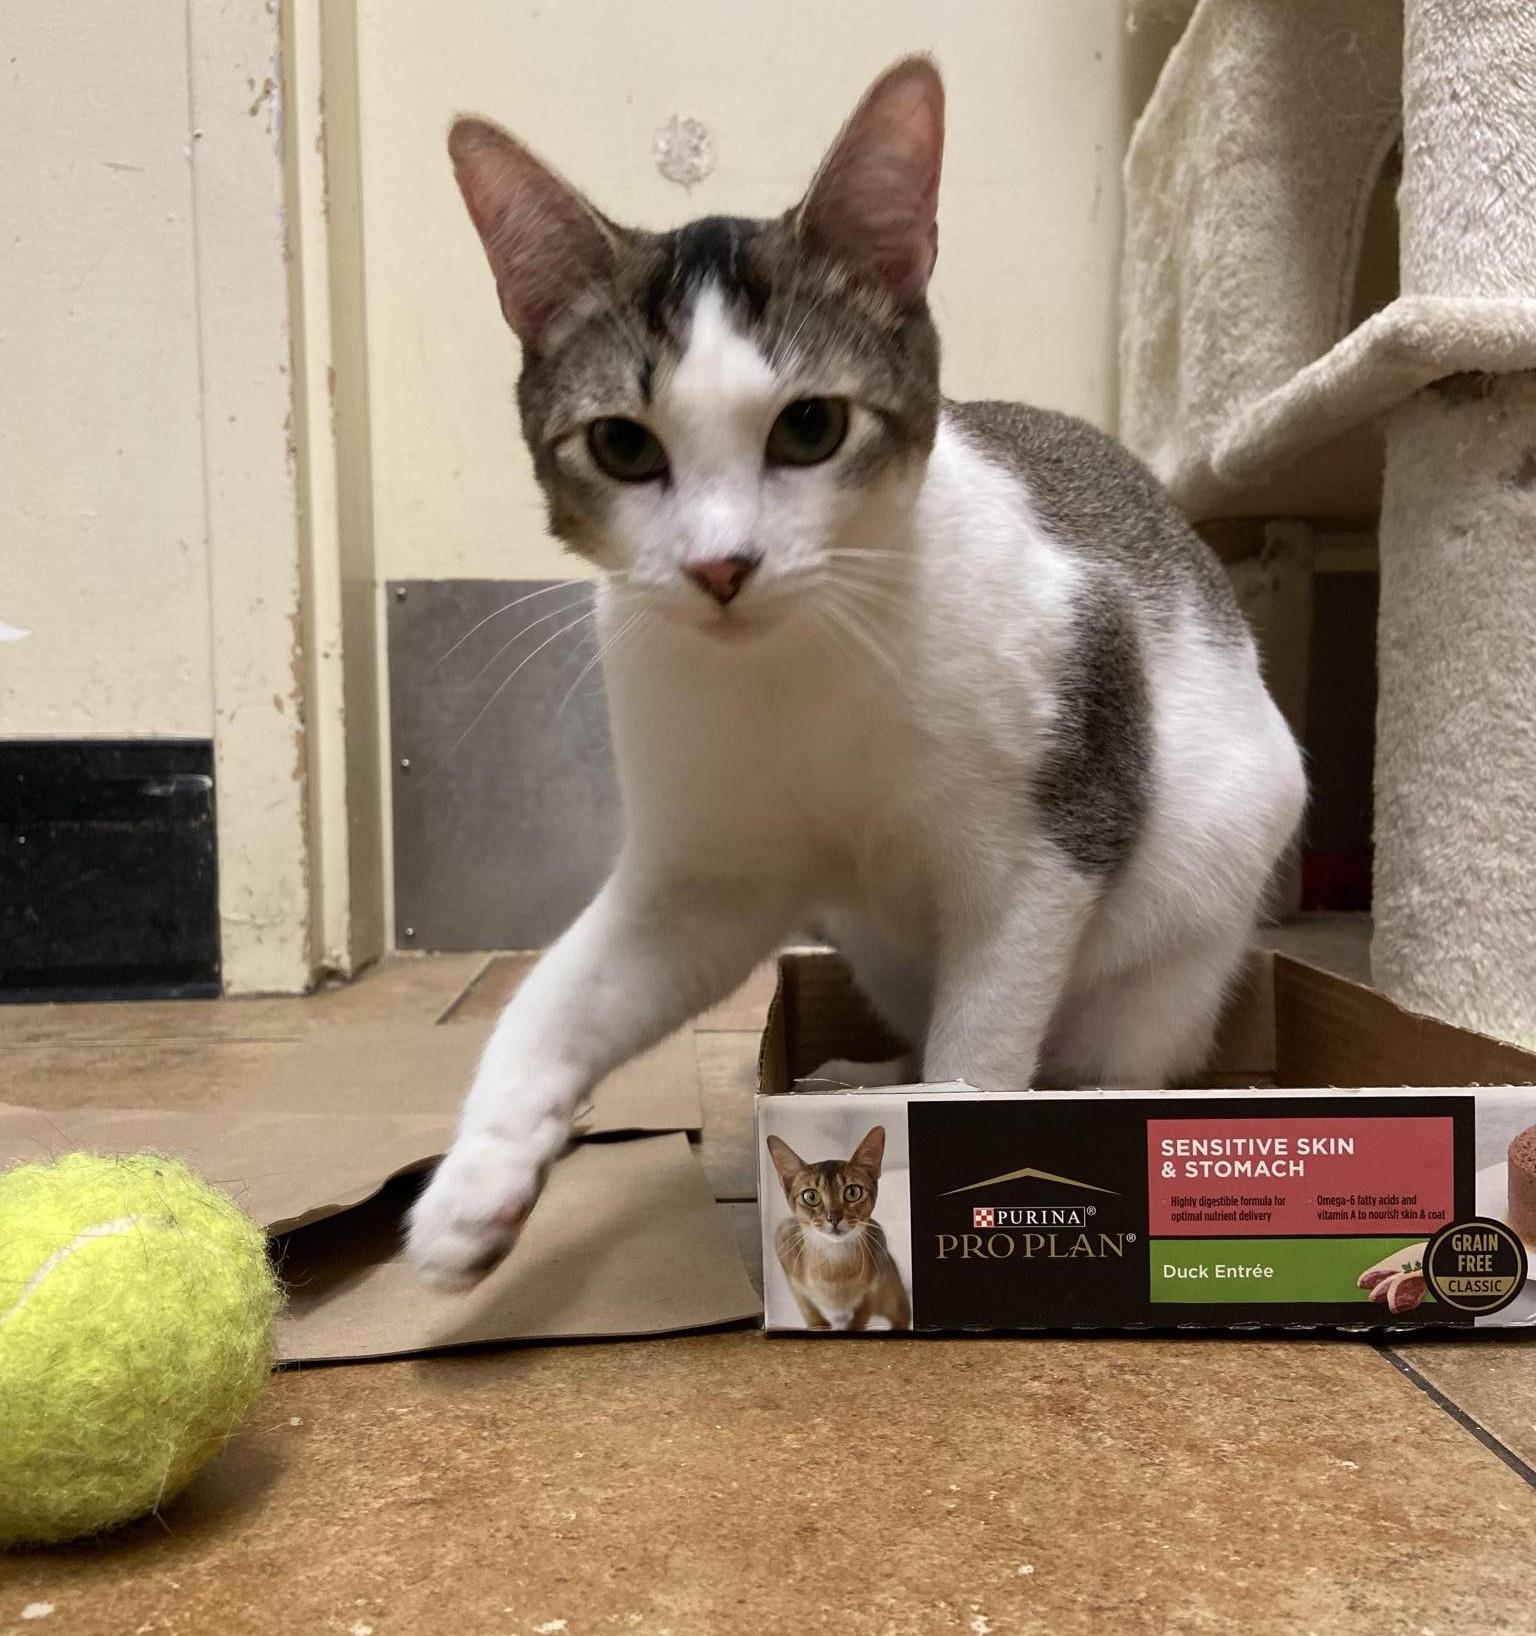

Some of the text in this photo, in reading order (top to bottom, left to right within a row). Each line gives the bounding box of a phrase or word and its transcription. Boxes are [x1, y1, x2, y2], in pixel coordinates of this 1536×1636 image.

[1161, 1138, 1355, 1156] SENSITIVE SKIN
[1161, 1160, 1305, 1178] & STOMACH
[1170, 1195, 1286, 1208] Highly digestible formula for
[1316, 1195, 1417, 1207] Omega-6 fatty acids and
[1170, 1210, 1272, 1223] optimal nutrient delivery
[1316, 1208, 1446, 1220] vitamin A to nourish skin & coat
[935, 1232, 1015, 1259] PRO
[1451, 1233, 1499, 1252] GRAIN
[1163, 1263, 1274, 1278] Duck Entrée
[1457, 1254, 1493, 1272] FREE
[1448, 1280, 1503, 1293] CLASSIC
